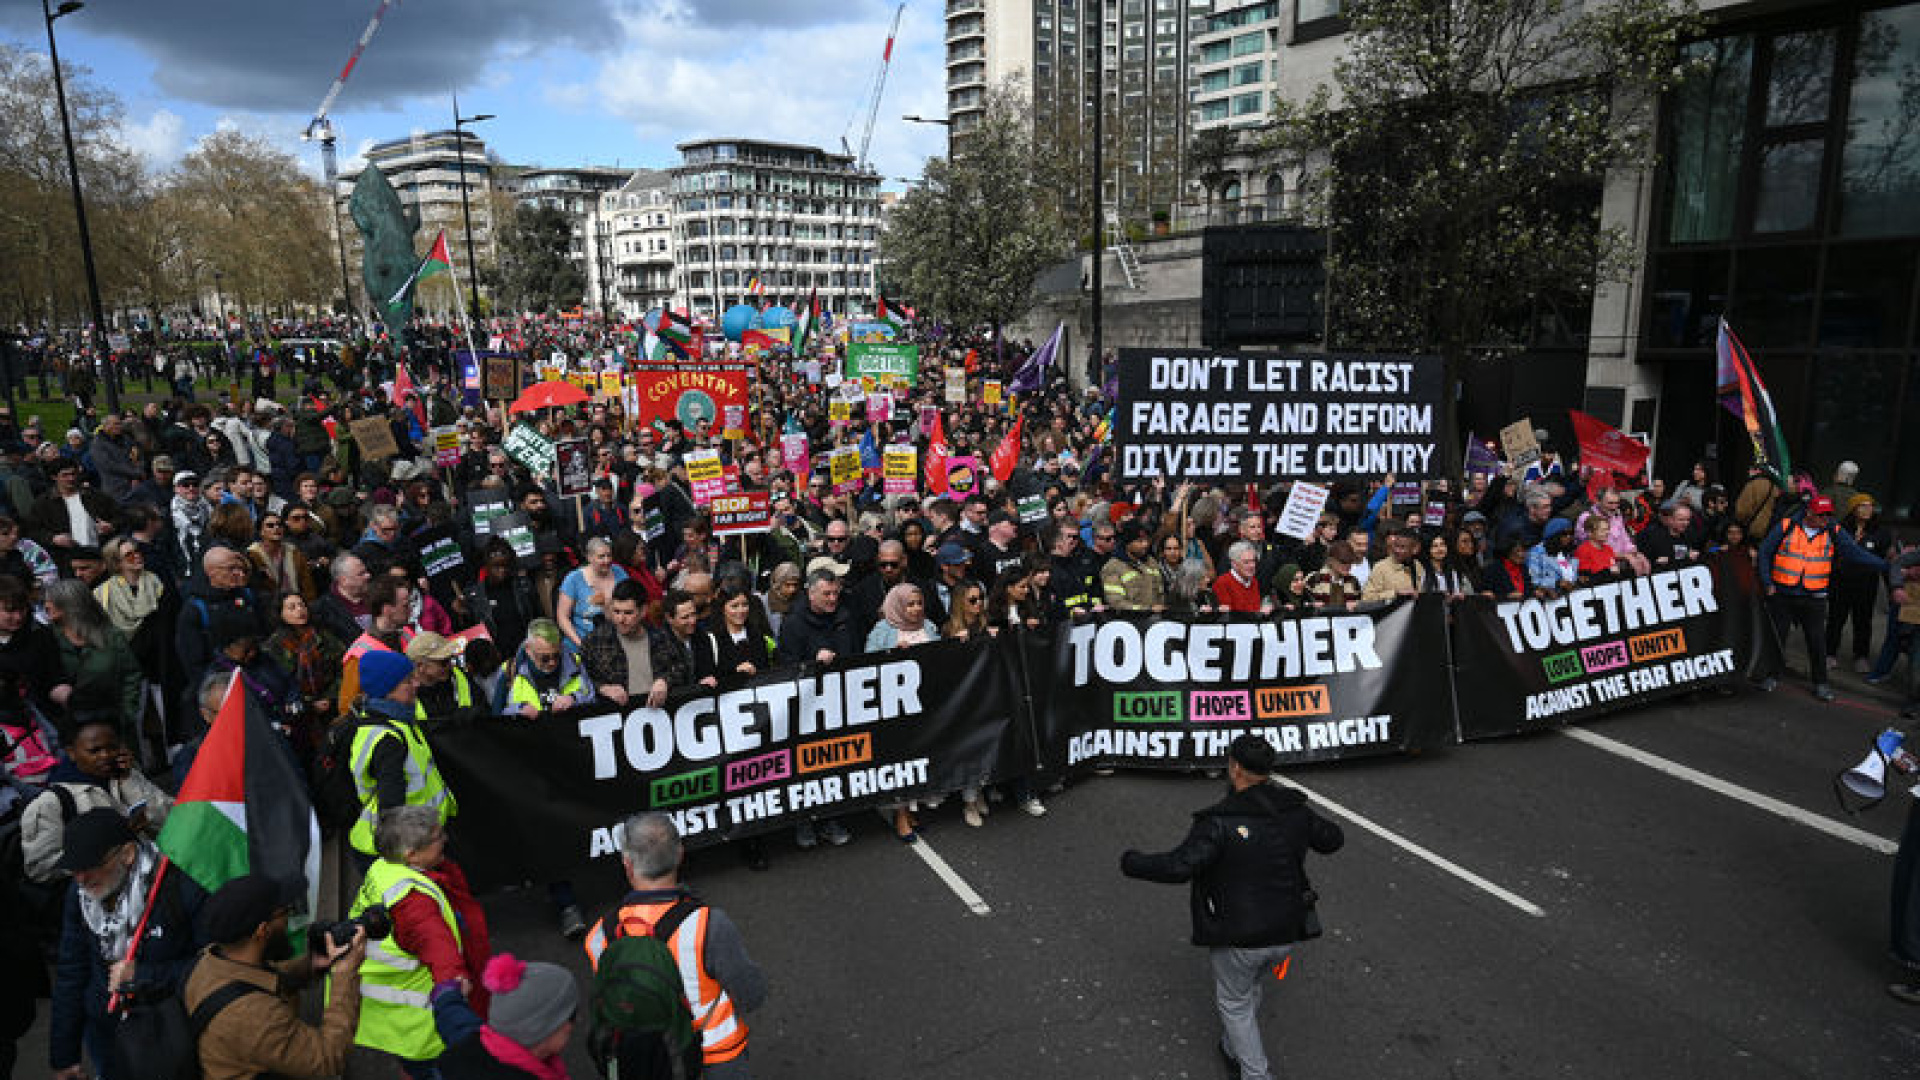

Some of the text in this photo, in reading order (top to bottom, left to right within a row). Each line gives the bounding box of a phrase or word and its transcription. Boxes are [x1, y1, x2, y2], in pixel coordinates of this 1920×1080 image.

[648, 372, 739, 401] COVENTRY
[1151, 358, 1414, 393] DON'T LET RACIST
[1132, 402, 1432, 434] FARAGE AND REFORM
[1123, 444, 1435, 475] DIVIDE THE COUNTRY
[714, 497, 749, 511] STOP
[714, 511, 767, 523] FAR RIGHT
[1497, 565, 1719, 653] TOGETHER
[1069, 615, 1383, 687] TOGETHER
[1547, 632, 1680, 678] LOVE HOPE UNITY
[1119, 690, 1321, 717] LOVE HOPE UNITY
[1525, 648, 1735, 720] AGAINST THE FAR RIGHT
[578, 660, 923, 780] TOGETHER
[1068, 729, 1184, 766] AGAINST
[1307, 715, 1392, 749] RIGHT
[657, 739, 865, 801] LOVE HOPE UNITY
[727, 787, 783, 824] THE
[788, 774, 843, 811] FAR
[849, 757, 930, 799] RIGHT
